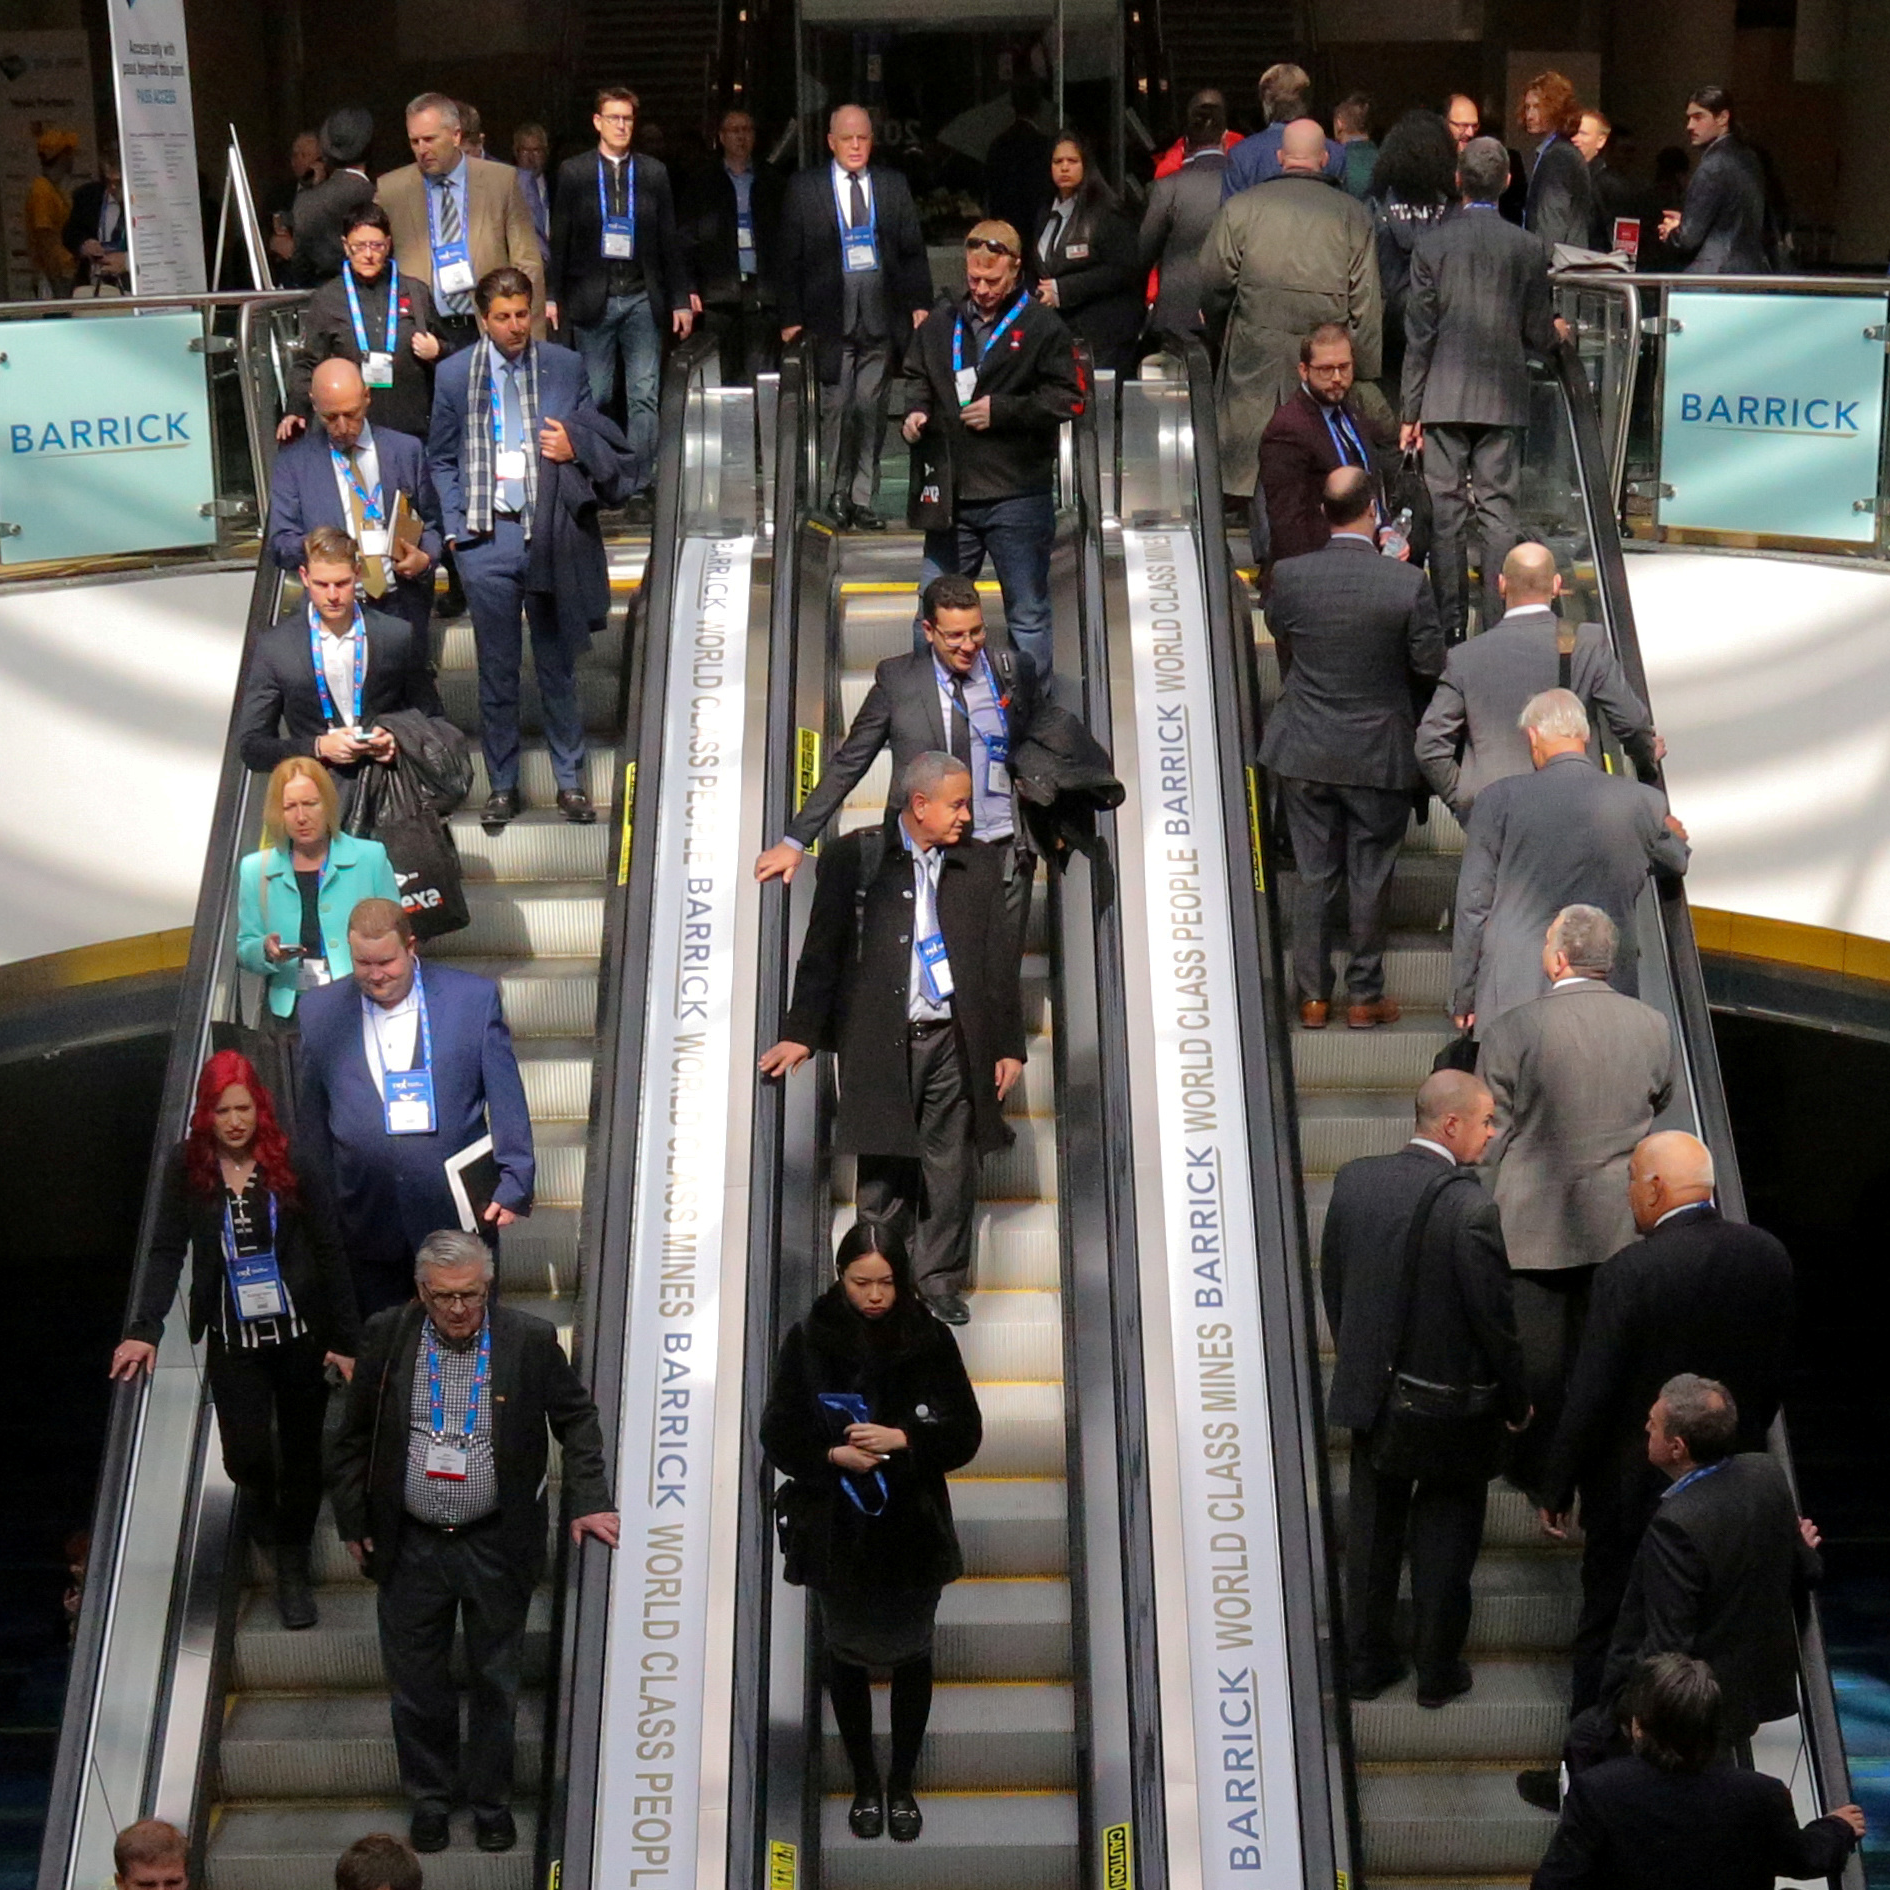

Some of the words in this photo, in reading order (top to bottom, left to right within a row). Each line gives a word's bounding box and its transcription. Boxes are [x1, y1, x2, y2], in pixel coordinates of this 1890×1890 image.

[11, 412, 190, 453] BARRICK
[1681, 393, 1860, 430] BARRICK
[703, 543, 734, 611] BARRICK
[1147, 566, 1180, 613] CLASS
[692, 620, 725, 690] WORLD
[1152, 618, 1186, 693] WORLD
[1157, 704, 1191, 836] BARRICK
[401, 888, 441, 909] exa
[1167, 848, 1204, 940] PEOPLE
[680, 878, 713, 1021] BARRICK
[1173, 950, 1211, 1030] CLASS
[1179, 1038, 1218, 1134] WORLD
[1185, 1145, 1223, 1308] BARRICK
[658, 1233, 697, 1318] MINES
[1196, 1322, 1238, 1412] MINES
[655, 1332, 692, 1509] BARRICK
[1202, 1422, 1245, 1522] CLASS
[642, 1523, 684, 1640] WORLD
[1209, 1533, 1254, 1651] WORLD
[635, 1652, 679, 1761] CLASS
[1217, 1666, 1261, 1870] BARRICK
[1109, 1828, 1126, 1887] CAUTION
